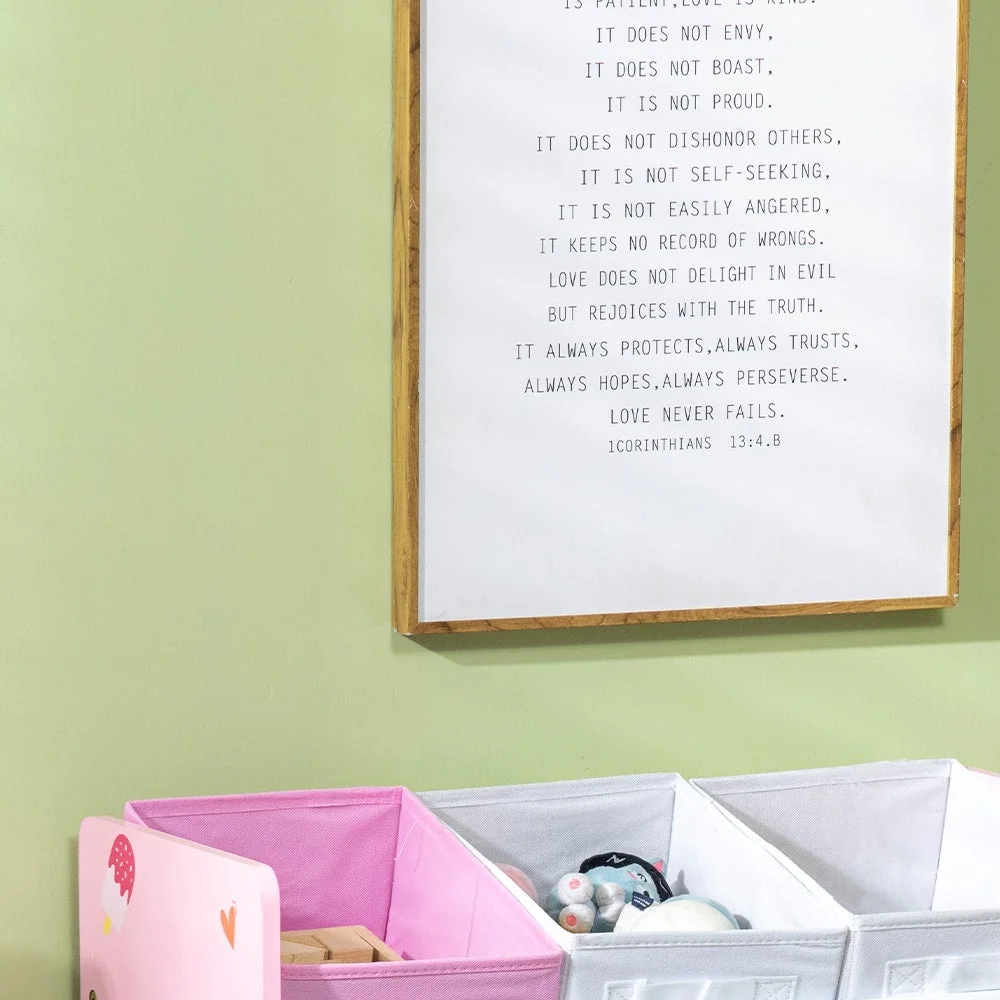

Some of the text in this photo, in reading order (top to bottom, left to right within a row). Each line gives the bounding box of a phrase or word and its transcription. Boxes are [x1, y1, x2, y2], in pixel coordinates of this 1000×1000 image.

[597, 24, 774, 43] IT DOES NOT ENVY,
[586, 58, 773, 78] IT DOES NOT BOAST,
[607, 93, 773, 112] IT IS NOT PROUD.
[536, 128, 841, 152] IT DOES NOT DISHONOR OTHERS,
[581, 161, 830, 185] IT IS NOT SELF-SEEKING,
[558, 197, 830, 220] IT IS NOT EASILY ANGERED,
[539, 230, 824, 254] IT KEEPS NO RECORD OF WRONGS.
[549, 263, 836, 288] LOVE DOES NOT DELIGHT IN EVIL
[548, 298, 824, 322] BUT REJOICES WITH THE TRUTH.
[515, 344, 535, 360] IT
[546, 341, 609, 358] ALWAYS
[789, 332, 859, 350] TRUSTS,
[524, 376, 587, 394] ALWAYS
[736, 367, 848, 385] PERSEVERSE.
[610, 403, 785, 425] LOVE NEVER FAILS.
[608, 436, 712, 453] 1CORINTHIANS
